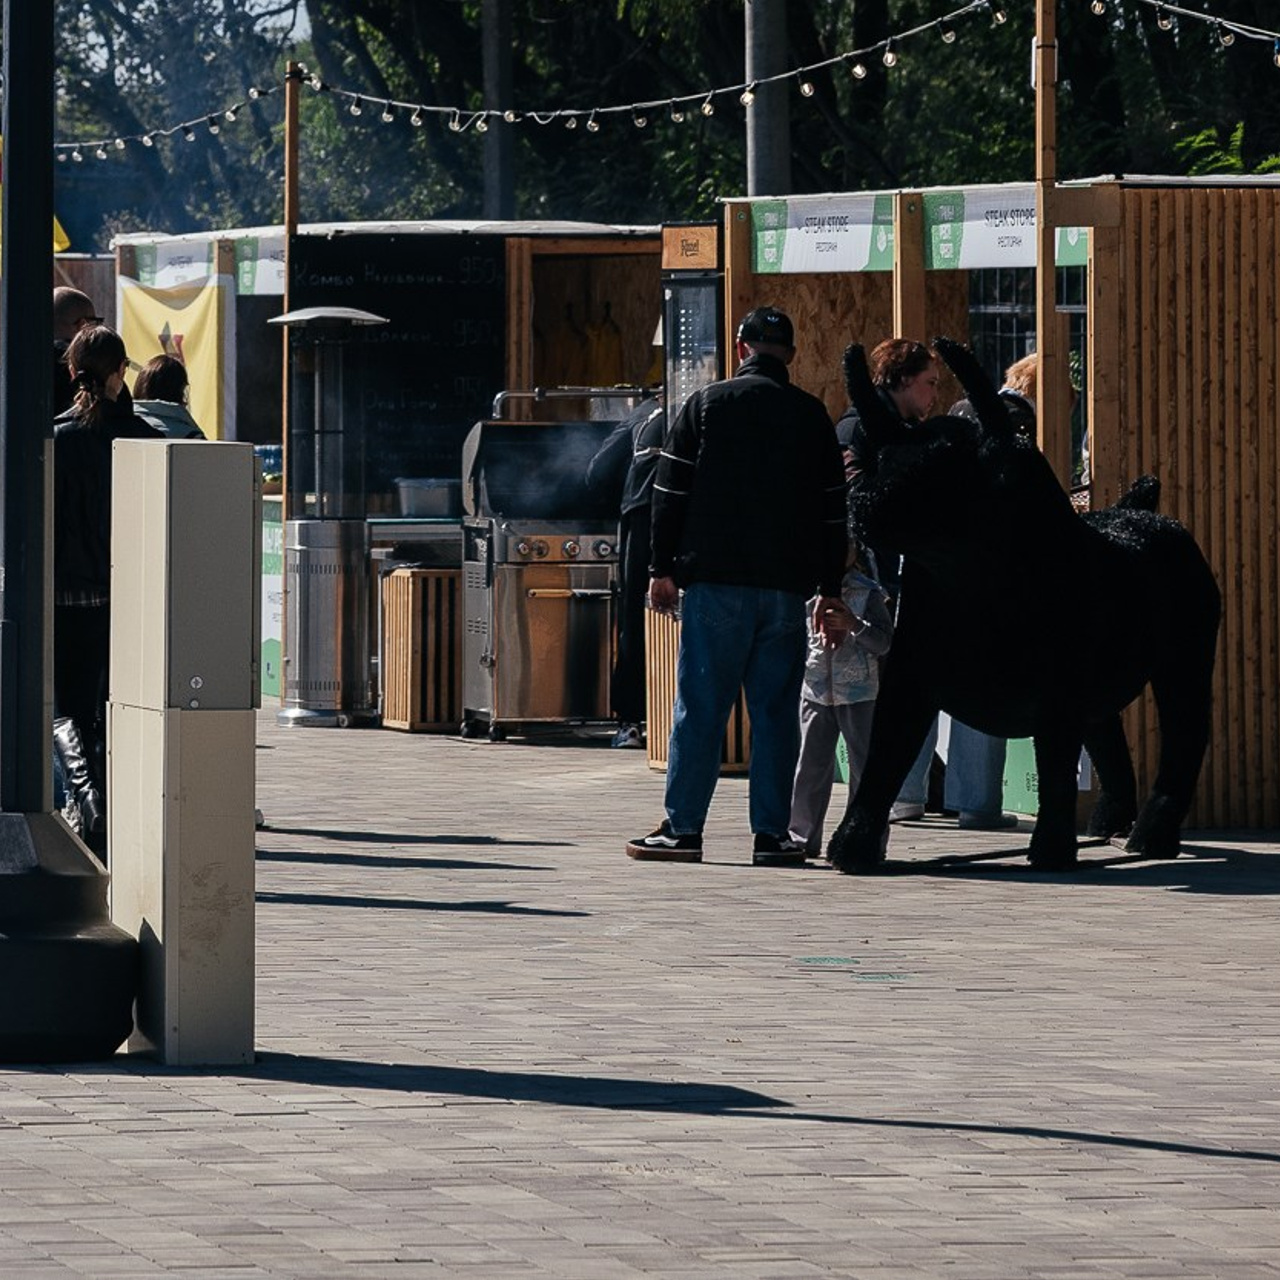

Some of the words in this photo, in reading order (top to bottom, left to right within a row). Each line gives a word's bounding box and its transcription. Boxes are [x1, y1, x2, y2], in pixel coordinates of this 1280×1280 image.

[804, 217, 826, 234] STEAK
[827, 215, 849, 233] STORE
[985, 210, 1009, 227] STEAK
[1010, 208, 1035, 226] STORE
